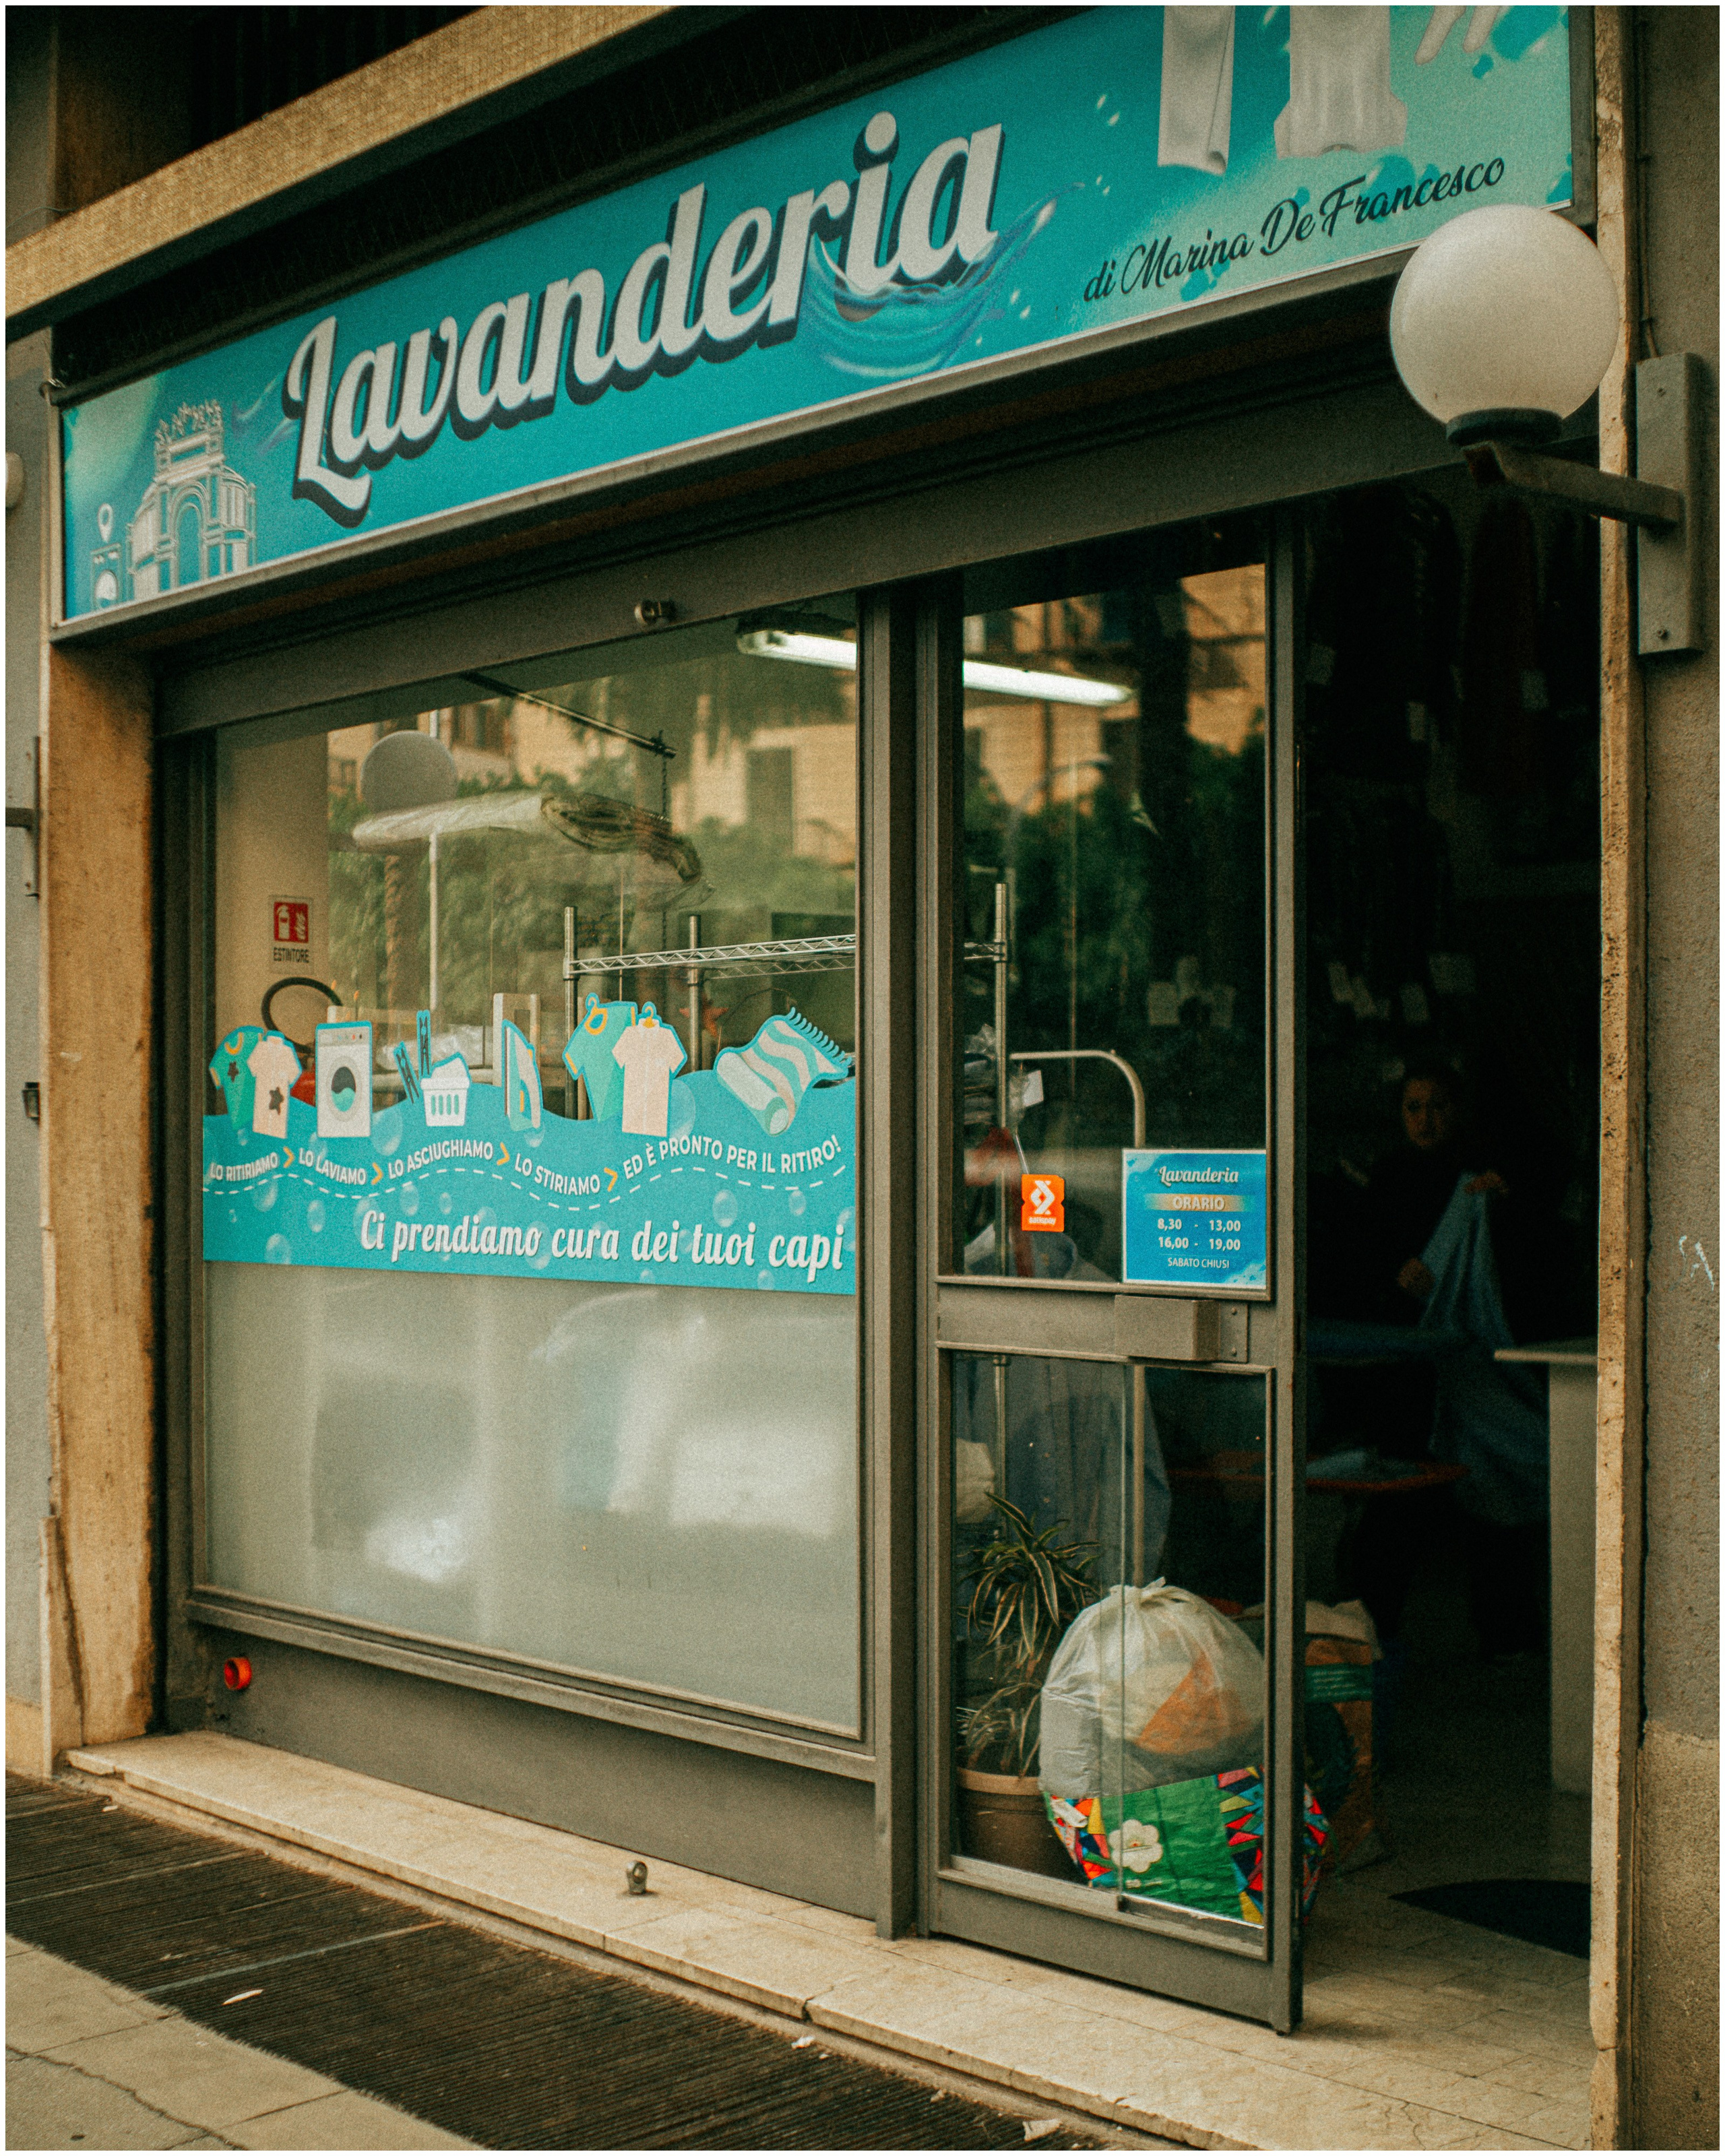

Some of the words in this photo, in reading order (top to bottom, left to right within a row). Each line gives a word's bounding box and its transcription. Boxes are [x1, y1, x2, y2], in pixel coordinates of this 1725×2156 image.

[1083, 259, 1116, 303] di
[1121, 229, 1255, 294] Marina
[1260, 198, 1316, 257] De
[1318, 156, 1505, 237] Francesco
[282, 110, 1003, 528] Lavanderia
[208, 1162, 224, 1180] LO
[225, 1151, 279, 1182] RITIRIAMO
[299, 1147, 314, 1168] LO
[315, 1154, 367, 1186] LAVIAMO
[387, 1158, 404, 1180] LO
[406, 1139, 494, 1173] ASCIUGHIAMO
[514, 1153, 532, 1177] LO
[534, 1165, 601, 1196] STIRIAMO
[623, 1154, 644, 1180] ED
[645, 1143, 658, 1168] È
[659, 1134, 723, 1161] PRONTO
[726, 1144, 757, 1172] PER
[761, 1151, 777, 1174] IL
[780, 1133, 842, 1174] RITIRO!
[1157, 1165, 1240, 1188] Lavanderia
[1172, 1195, 1226, 1211] ORARIO
[1028, 1215, 1057, 1226] satispay
[1157, 1217, 1183, 1232] 8,30
[1210, 1219, 1241, 1232] 13,00
[360, 1209, 386, 1251] Ci
[391, 1215, 542, 1263] prendiamo
[551, 1226, 620, 1261] cura
[631, 1219, 681, 1264] dei
[691, 1222, 757, 1267] tuoi
[767, 1223, 845, 1283] capi
[1158, 1236, 1189, 1250] 16,00
[1210, 1237, 1241, 1251] 19,00
[1168, 1257, 1200, 1269] SABATO
[1201, 1258, 1230, 1269] CHIUSI
